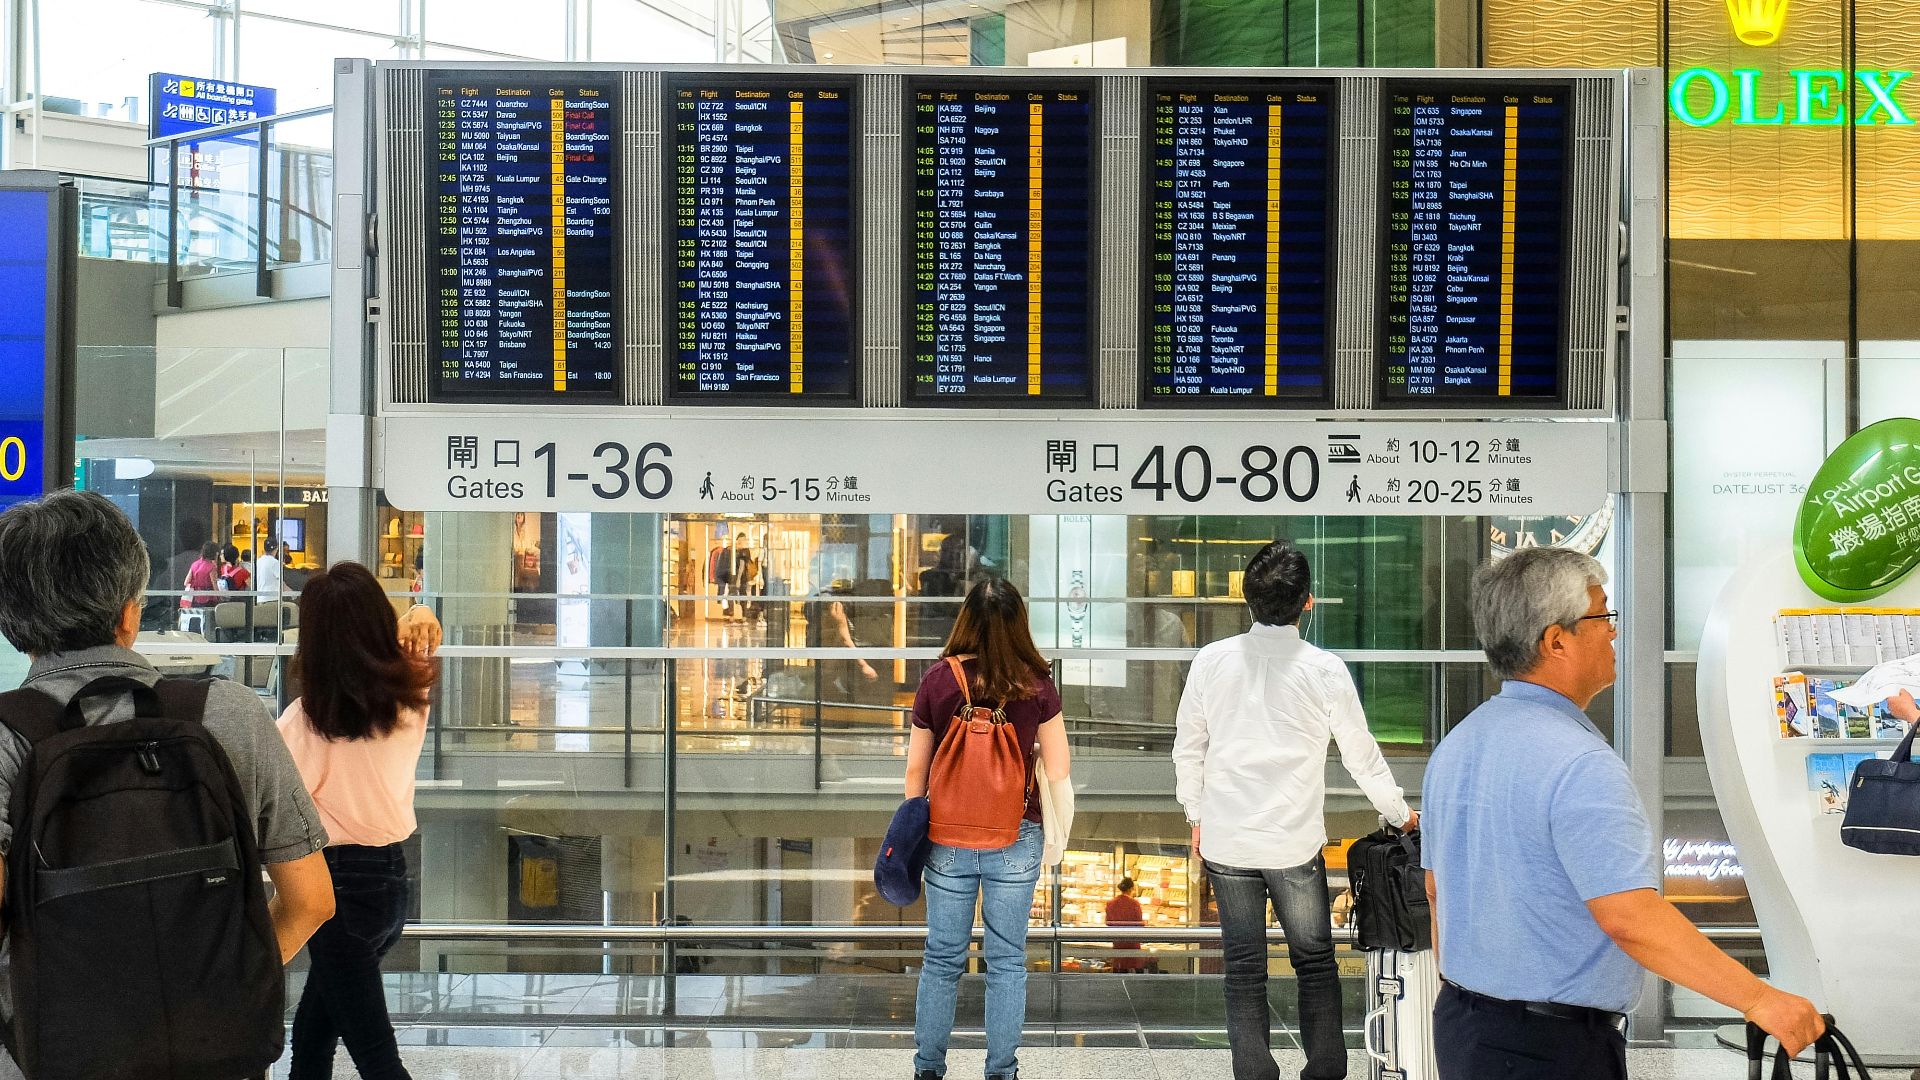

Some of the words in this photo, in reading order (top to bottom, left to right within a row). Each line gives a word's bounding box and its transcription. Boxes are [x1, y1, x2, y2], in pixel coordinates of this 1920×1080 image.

[438, 88, 453, 96] Time
[461, 88, 479, 97] Flight
[496, 88, 531, 96] Destination
[579, 89, 599, 97] Status
[700, 91, 718, 99] Flight
[788, 91, 804, 99] Gate
[818, 91, 838, 99] Status
[940, 93, 958, 101] Flight
[974, 93, 1009, 101] Destination
[1027, 93, 1043, 101] Gate
[1057, 93, 1078, 101] Status
[207, 94, 235, 104] boarding
[236, 98, 254, 106] gates
[438, 100, 456, 108] 12:15
[461, 100, 471, 108] CZ
[471, 100, 488, 108] 7444
[1179, 94, 1197, 103] Flight
[1297, 95, 1317, 103] Status
[1416, 96, 1434, 104] Flight
[1533, 96, 1553, 104] Status
[735, 103, 767, 111] Seoul/ICN
[1416, 107, 1427, 115] CX
[1427, 107, 1440, 115] 635
[1451, 108, 1482, 116] Singapore
[1213, 117, 1253, 125] London/LHR
[516, 175, 540, 184] Lumpur
[582, 176, 607, 184] Change
[1155, 180, 1173, 188] 14:50
[1178, 180, 1189, 188] CX
[1190, 180, 1201, 188] 171
[1212, 180, 1230, 188] Perth
[1448, 213, 1476, 222] Taichung
[973, 263, 1006, 272] Nanchang
[567, 341, 578, 349] Est
[735, 363, 754, 371] Taipei
[1386, 438, 1400, 453] 約
[1488, 438, 1521, 453] 分鐘
[447, 436, 520, 470] 閘口
[1046, 440, 1120, 474] 閘口
[1367, 453, 1400, 464] About
[1410, 440, 1480, 464] 10-12
[1488, 453, 1532, 464] Minutes
[447, 475, 524, 500] Gates
[534, 441, 673, 500] 1-36
[1046, 480, 1123, 504] Gates
[1130, 445, 1320, 503] 40-80
[741, 475, 755, 490] 約
[826, 475, 858, 491] 分鐘
[1386, 478, 1400, 493] 約
[1488, 478, 1521, 493] 分鐘
[720, 491, 755, 502] About
[761, 477, 820, 502] 5-15
[1367, 493, 1400, 504] About
[1407, 480, 1483, 504] 20-25
[1713, 484, 1785, 494] DATEJUST
[1789, 484, 1806, 494] 36
[303, 491, 329, 502] BAL
[826, 491, 871, 503] Minutes
[1489, 493, 1533, 504] Minutes
[1832, 474, 1906, 519] Airport
[1829, 493, 1920, 553] 機場指南
